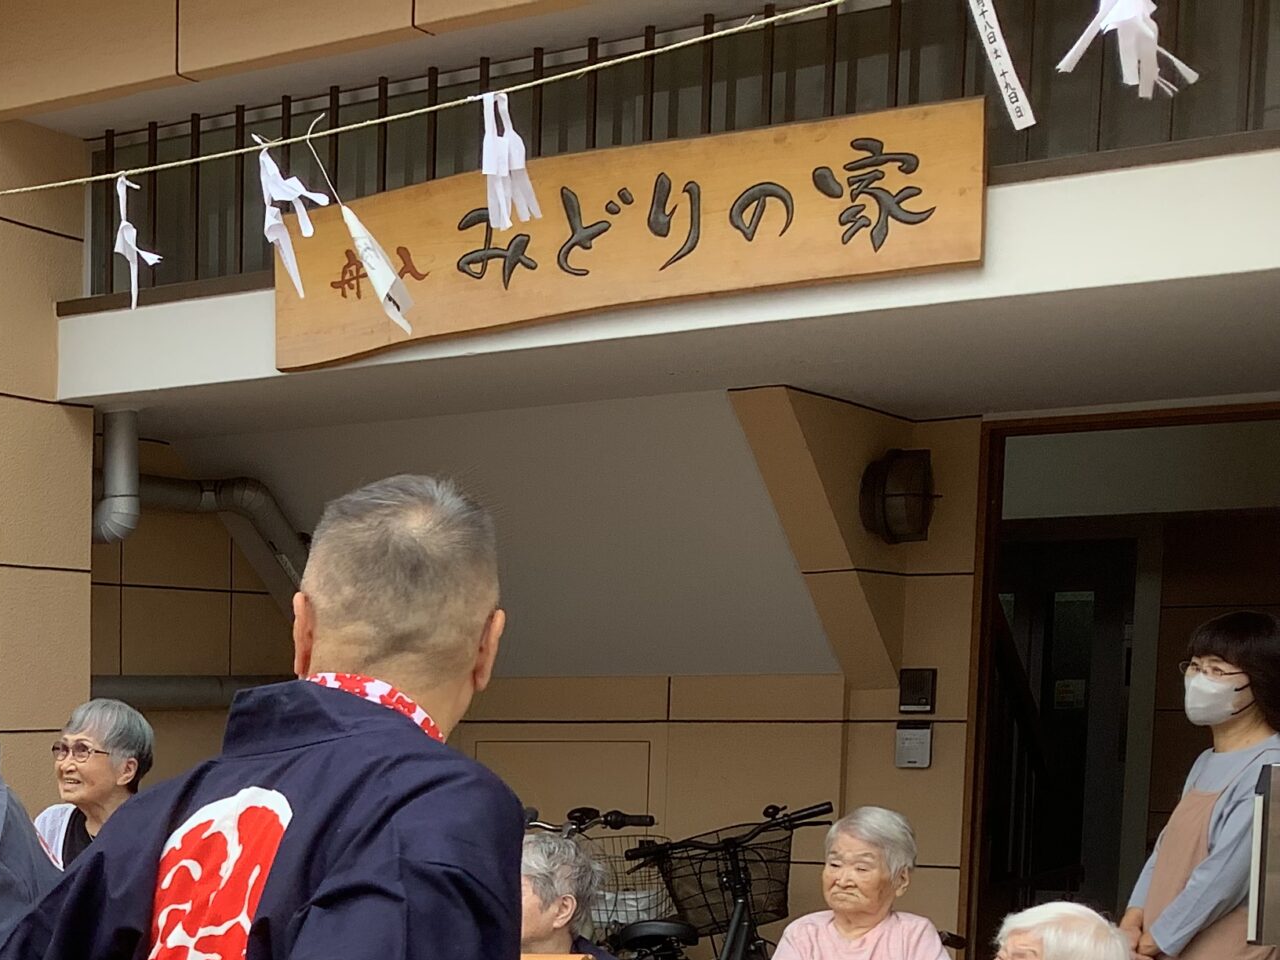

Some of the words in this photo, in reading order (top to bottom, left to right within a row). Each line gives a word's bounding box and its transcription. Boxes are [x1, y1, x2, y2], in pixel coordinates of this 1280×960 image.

[457, 137, 936, 290] みどりの家
[330, 247, 430, 300] 舟入
